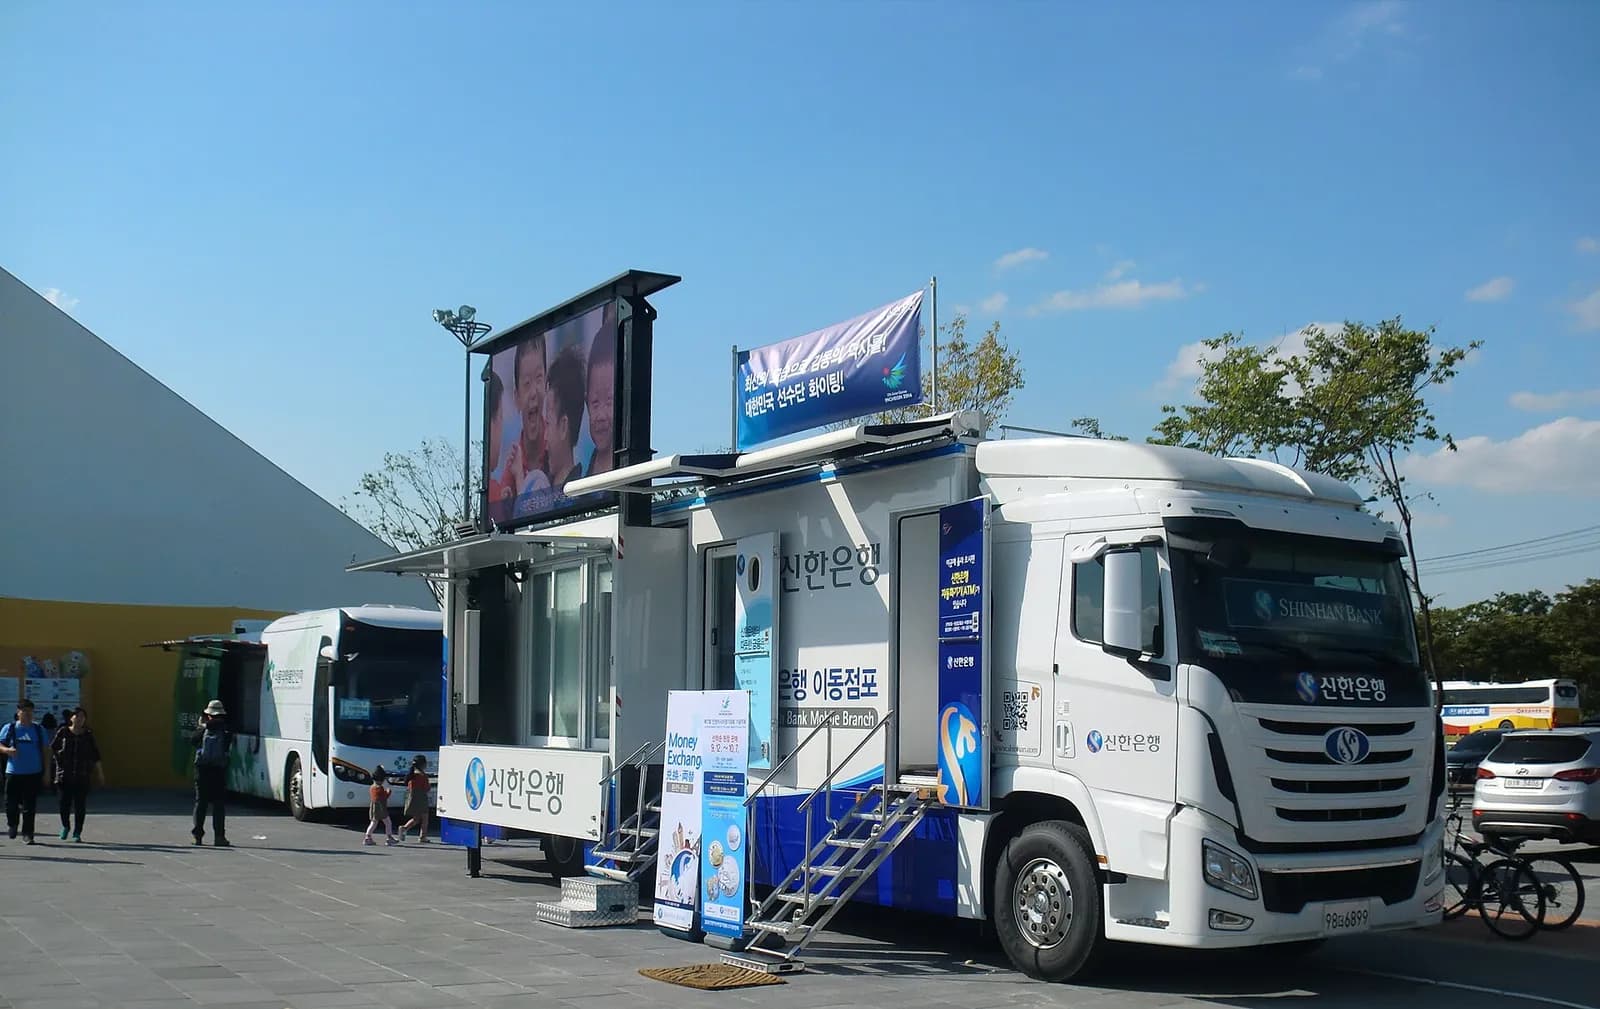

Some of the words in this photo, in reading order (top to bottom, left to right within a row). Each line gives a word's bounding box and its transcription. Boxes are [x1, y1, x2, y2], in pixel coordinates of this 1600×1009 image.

[745, 391, 775, 418] 대한민국
[777, 381, 806, 408] 선수단
[808, 370, 845, 398] 화이팅!
[780, 543, 881, 593] 신한은행
[1279, 598, 1345, 621] SHINHAN
[1346, 605, 1383, 625] BANK
[813, 667, 878, 701] 이동점포
[1320, 676, 1386, 701] 신한은행
[842, 710, 875, 727] Branch
[668, 732, 698, 751] Money
[1104, 734, 1161, 753] 신한은행
[488, 767, 564, 815] 신한은행
